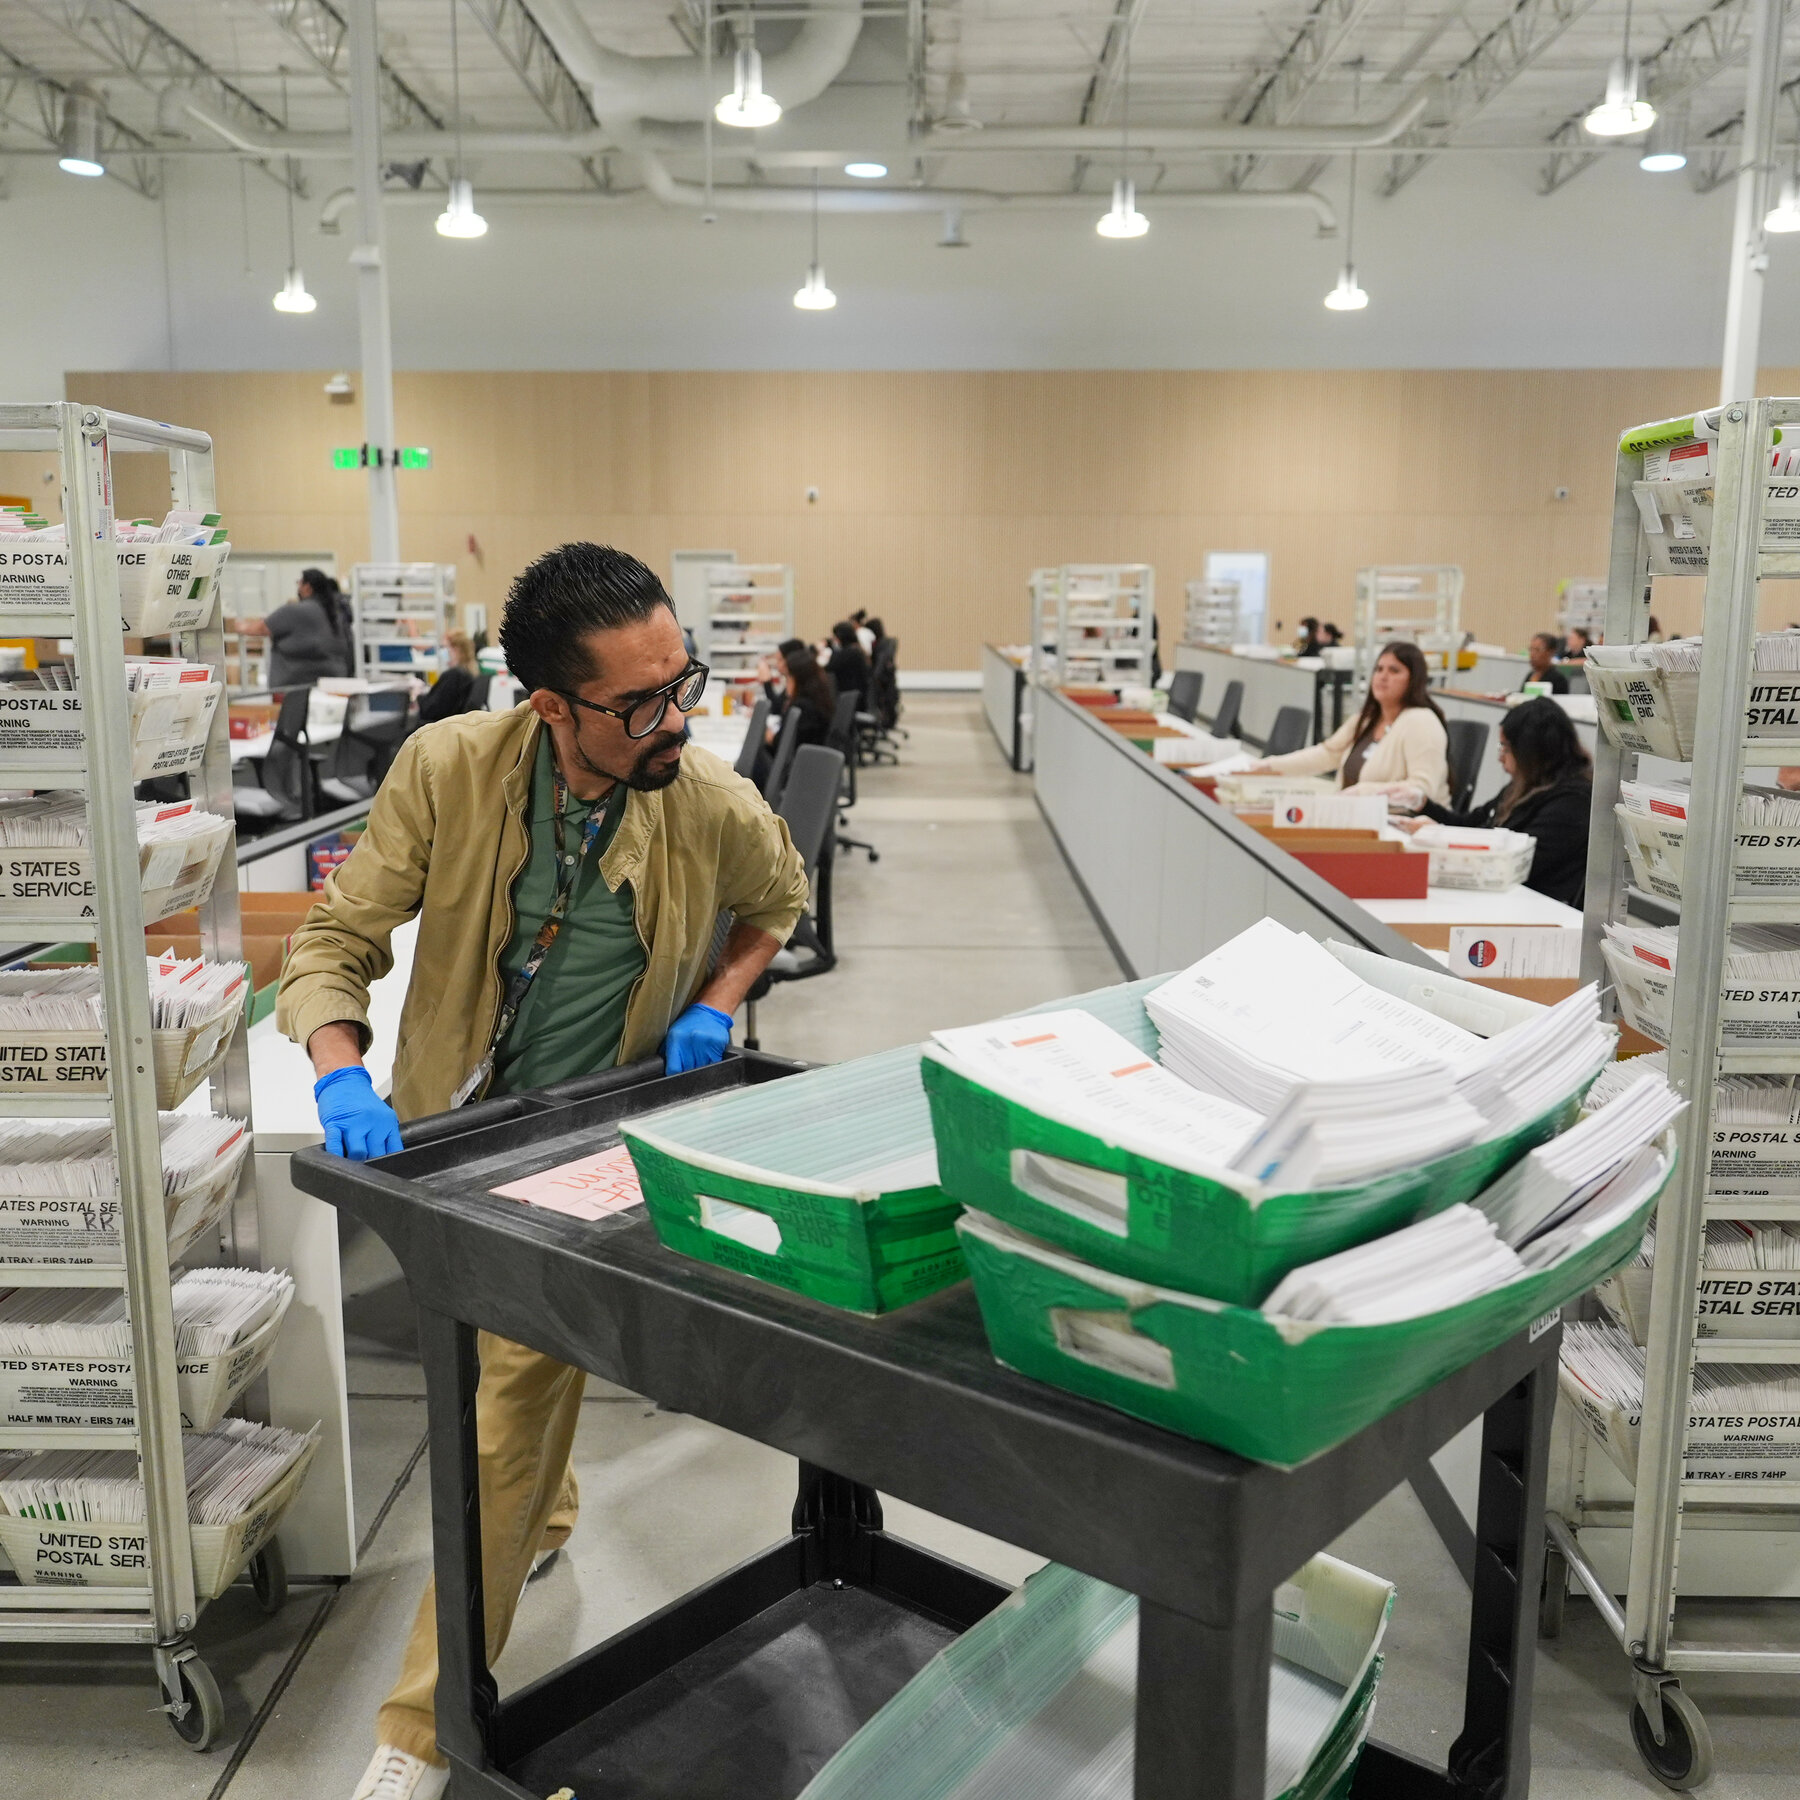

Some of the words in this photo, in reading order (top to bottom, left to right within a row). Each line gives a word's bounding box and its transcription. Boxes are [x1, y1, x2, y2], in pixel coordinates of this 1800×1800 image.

[12, 554, 68, 566] POSTA
[172, 554, 192, 566] LABEL
[1670, 556, 1689, 564] POSTAL
[166, 569, 190, 580] OTHER
[167, 584, 182, 595] END
[1624, 681, 1650, 692] LABEL
[0, 698, 58, 710] POSTAL
[1628, 694, 1656, 706] OTHER
[1637, 706, 1654, 718] END
[10, 862, 80, 876] STATES
[12, 882, 92, 896] SERVICE
[1729, 1132, 1788, 1143] POSTAL
[1712, 1150, 1757, 1158] ARNING
[40, 1202, 94, 1212] POSTAL
[776, 1191, 827, 1214] LABEL
[20, 1218, 70, 1226] WARNING
[798, 1227, 834, 1248] END
[711, 1240, 749, 1262] UNITED
[32, 1362, 84, 1372] STATES
[69, 1378, 118, 1387] WARNING
[8, 1414, 32, 1423] HALF
[36, 1415, 54, 1424] MM
[55, 1416, 82, 1424] TRAY
[90, 1416, 114, 1424] EIRS
[1689, 1417, 1744, 1428] STATES
[1761, 1471, 1787, 1479] 74HP
[40, 1532, 102, 1550] UNITED
[36, 1549, 104, 1566] POSTAL
[35, 1569, 83, 1578] WARNING
